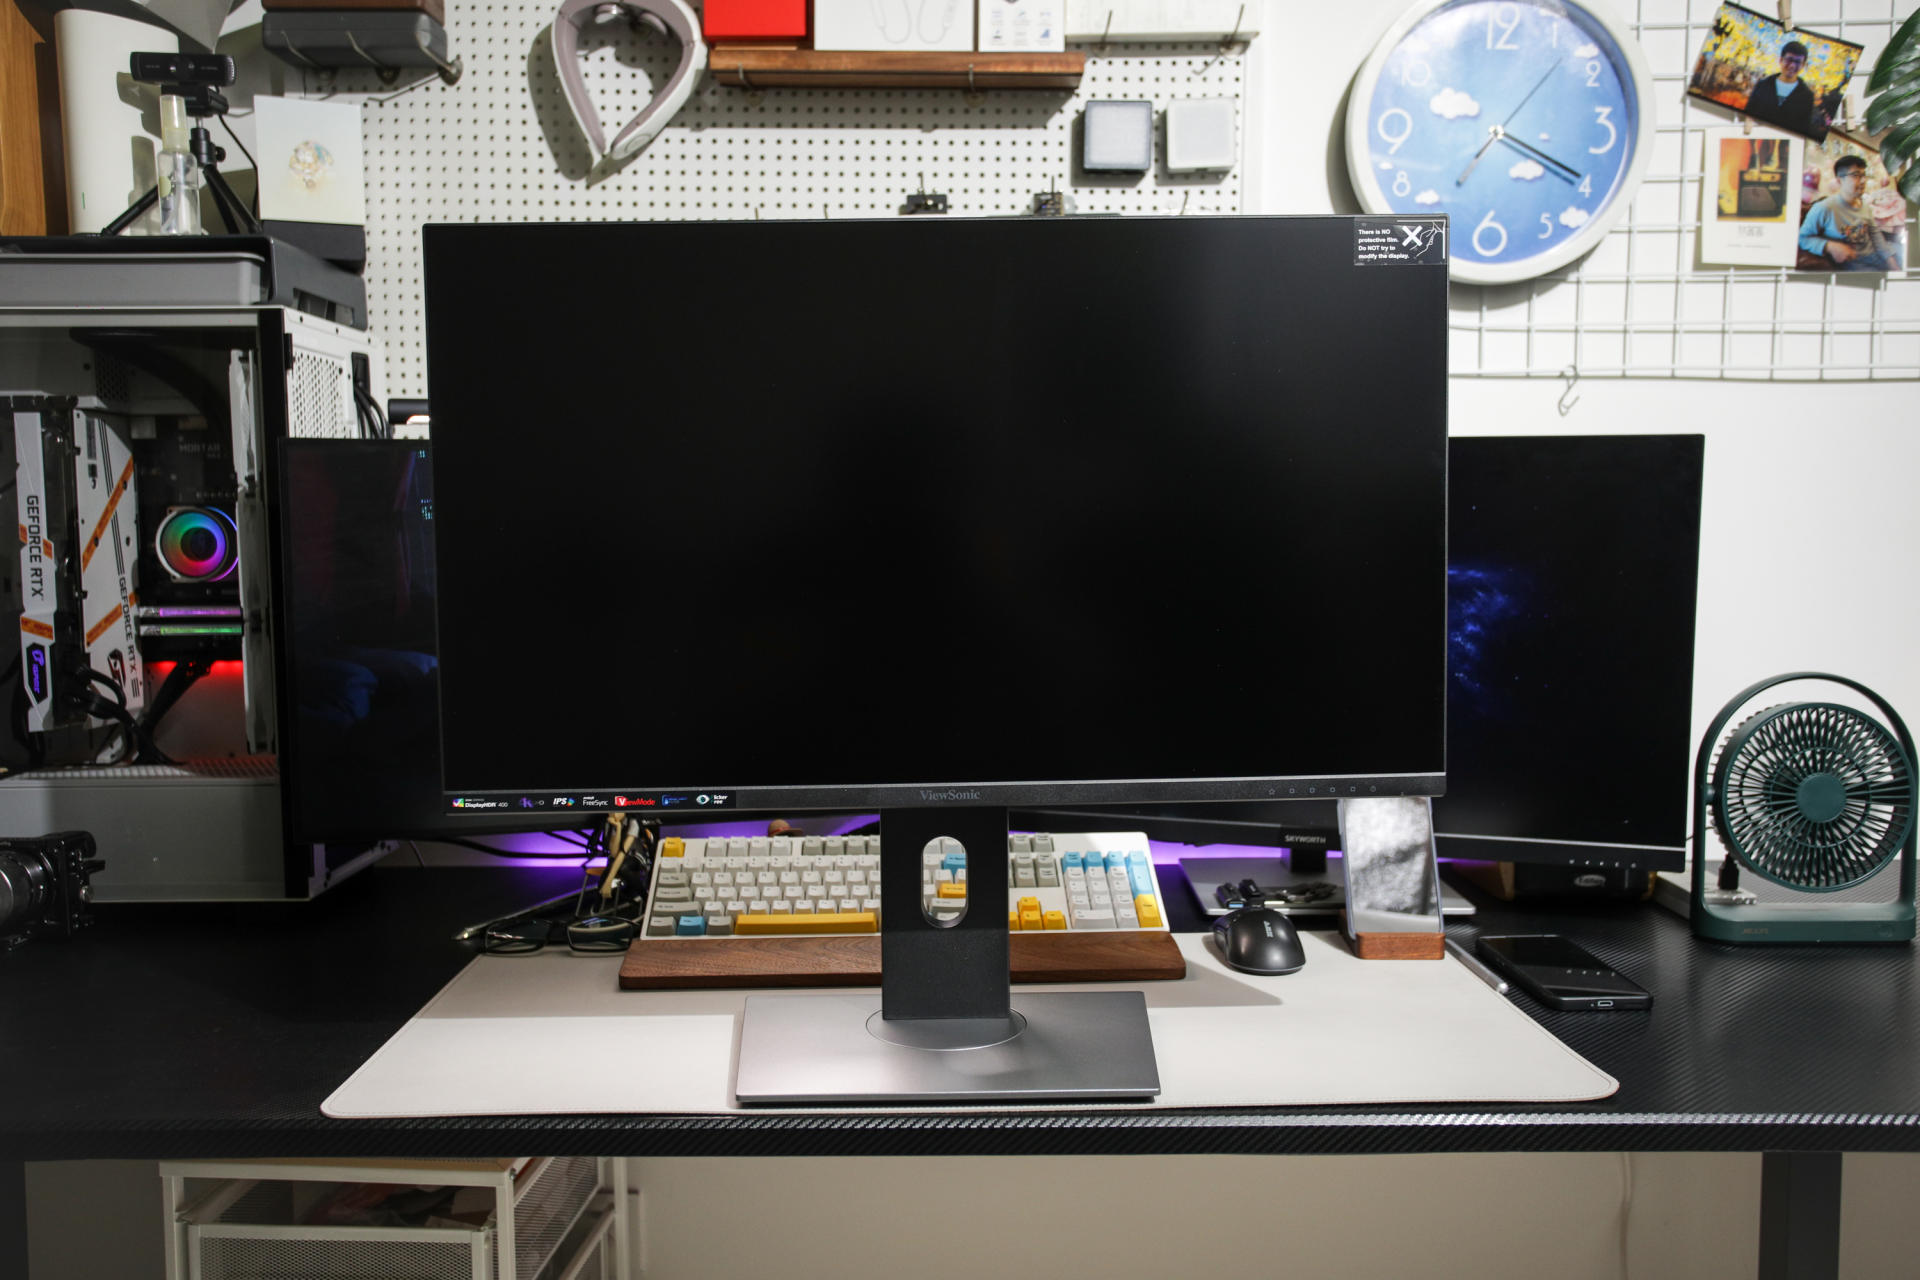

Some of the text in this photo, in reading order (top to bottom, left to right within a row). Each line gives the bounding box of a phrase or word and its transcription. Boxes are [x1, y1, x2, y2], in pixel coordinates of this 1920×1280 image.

[1485, 2, 1521, 50] 12
[1585, 60, 1601, 87] 2
[1377, 107, 1413, 155] 9
[1588, 106, 1617, 155] 3
[1391, 170, 1412, 198] 8
[1578, 174, 1593, 199] 4
[1472, 209, 1508, 257] 6
[1537, 212, 1554, 239] 5
[26, 495, 44, 598] GEFORCE RTX
[119, 577, 138, 673] GEFORCE RTX
[553, 797, 568, 805] IPS
[919, 788, 981, 801] ViewSonic
